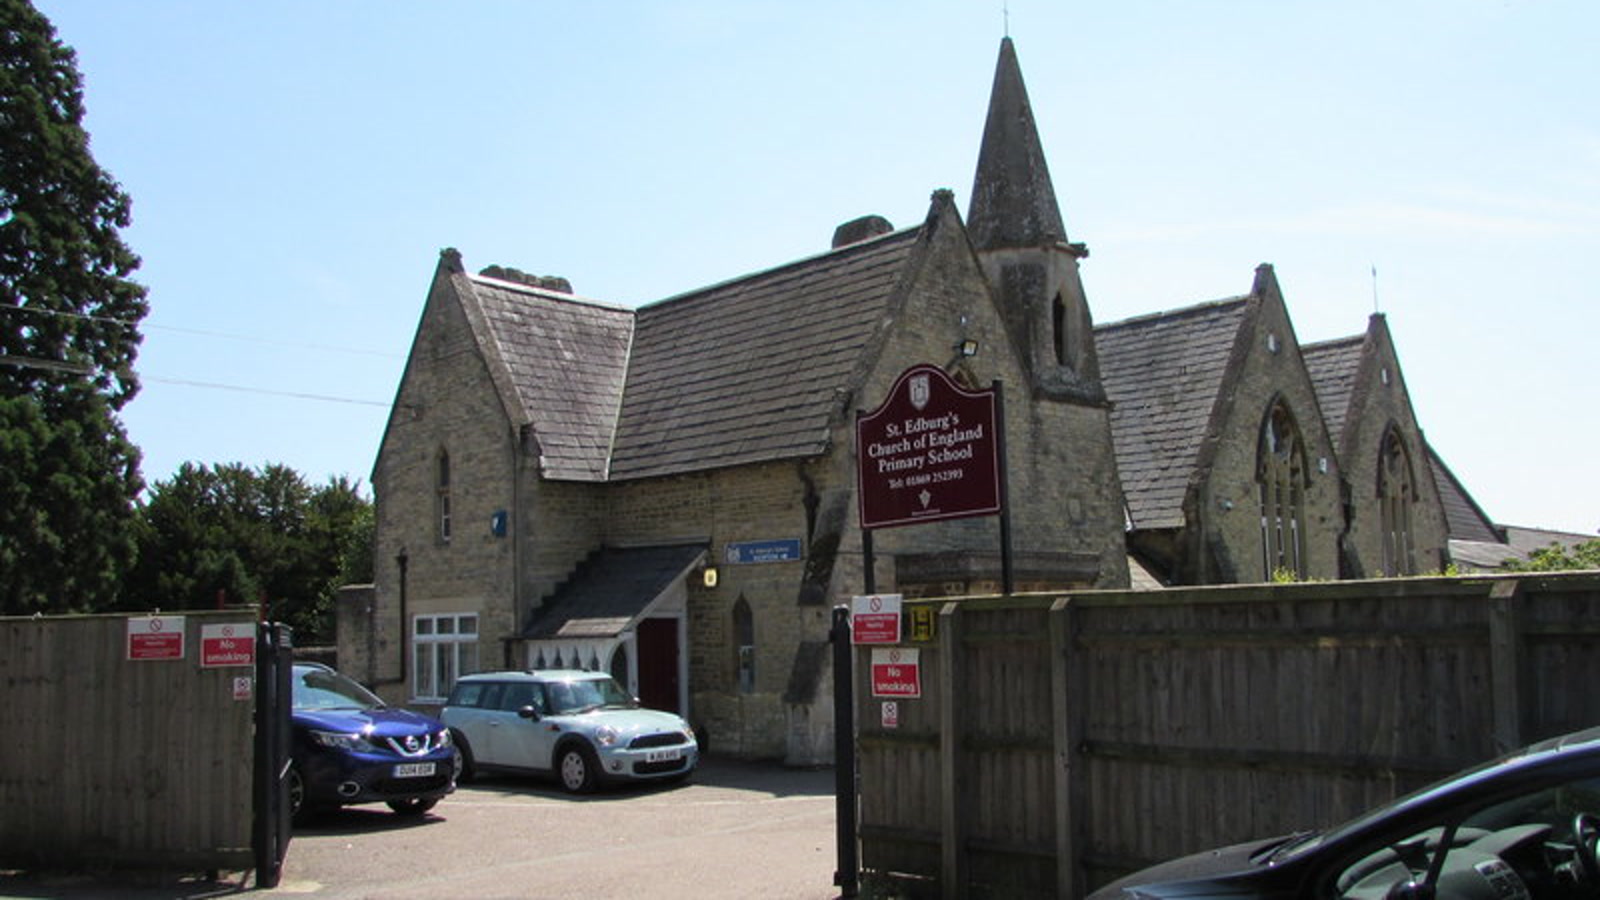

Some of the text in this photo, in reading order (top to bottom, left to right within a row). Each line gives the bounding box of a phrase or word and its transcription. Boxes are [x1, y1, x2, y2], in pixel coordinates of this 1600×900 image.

[886, 411, 959, 438] St. Edburg's
[868, 424, 983, 458] Church of England
[879, 444, 973, 474] Primary School
[219, 639, 236, 650] No
[206, 653, 251, 663] smoking
[887, 665, 902, 677] No
[876, 681, 915, 693] smoking
